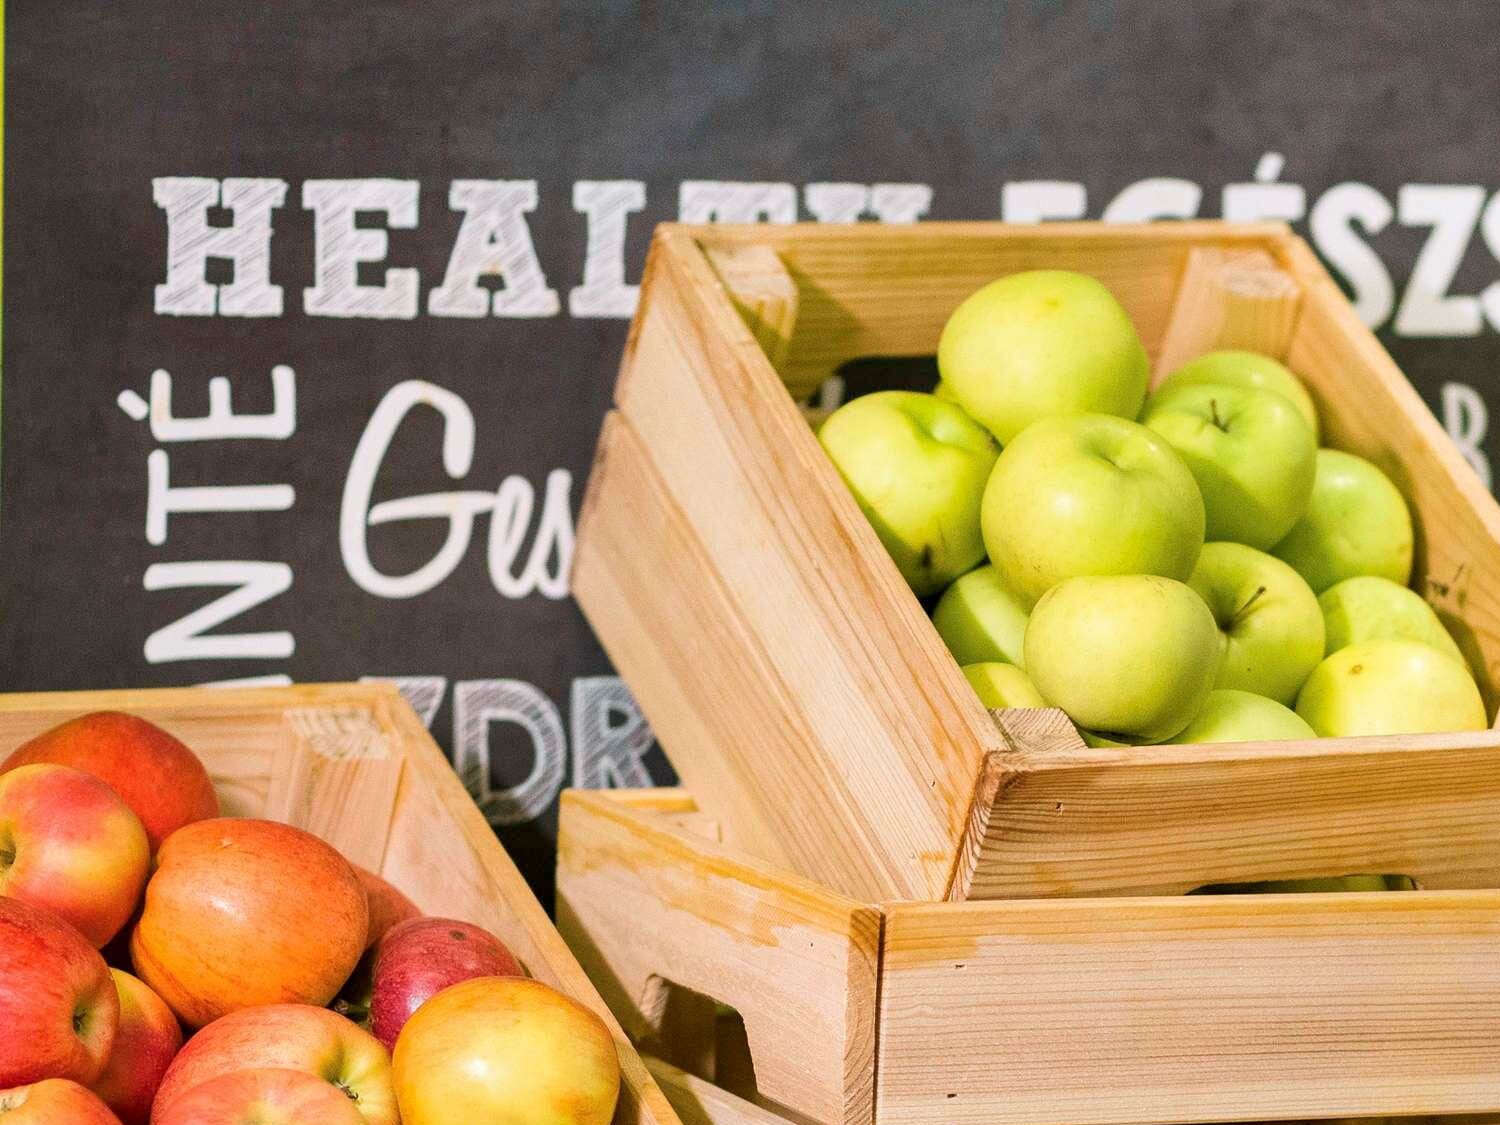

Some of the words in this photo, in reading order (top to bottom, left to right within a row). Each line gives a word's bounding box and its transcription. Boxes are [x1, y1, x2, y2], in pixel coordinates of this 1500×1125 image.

[150, 176, 934, 321] HEAL
[116, 364, 297, 689] NTÉ
[357, 675, 656, 826] DR
